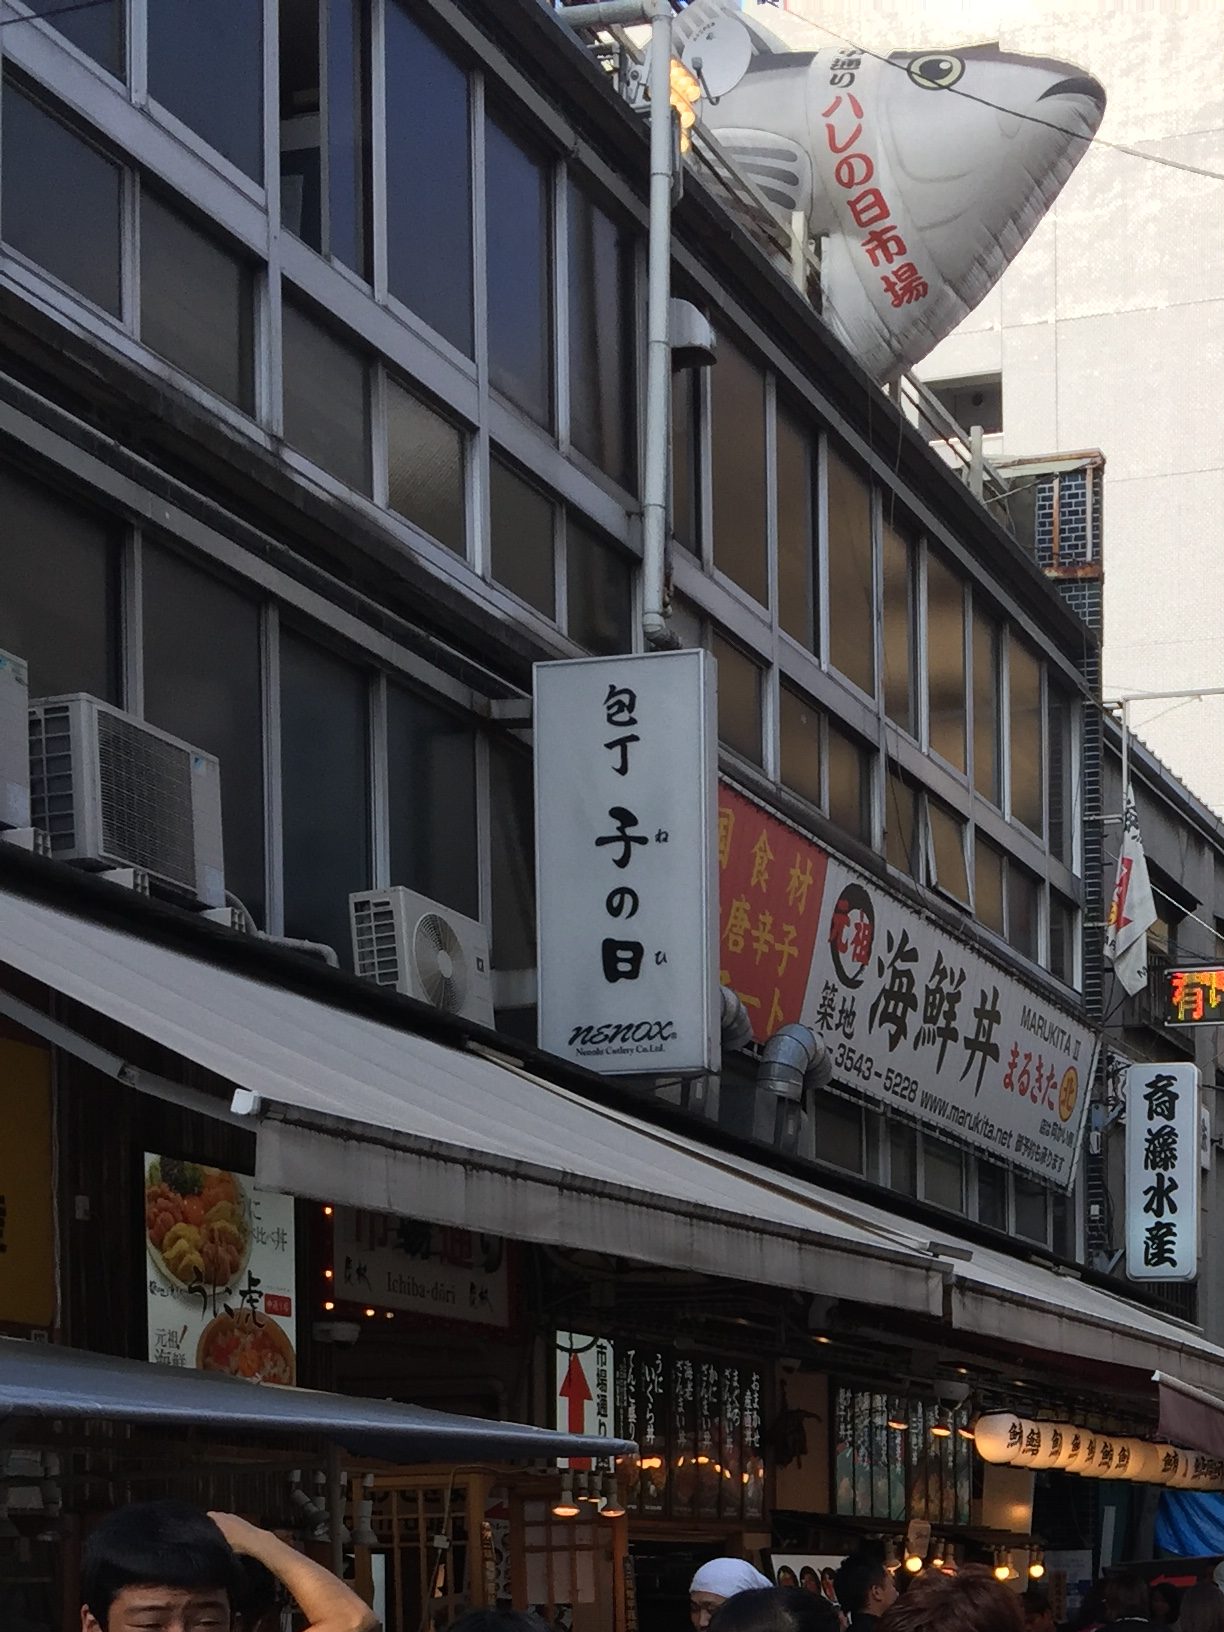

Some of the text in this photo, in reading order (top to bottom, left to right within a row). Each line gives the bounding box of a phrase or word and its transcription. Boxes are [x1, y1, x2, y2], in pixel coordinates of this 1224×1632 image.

[821, 92, 929, 308] ハレの日市場
[603, 684, 641, 776] 包丁
[868, 928, 1002, 1098] 海鮮丼
[1003, 1041, 1058, 1112] まるきた
